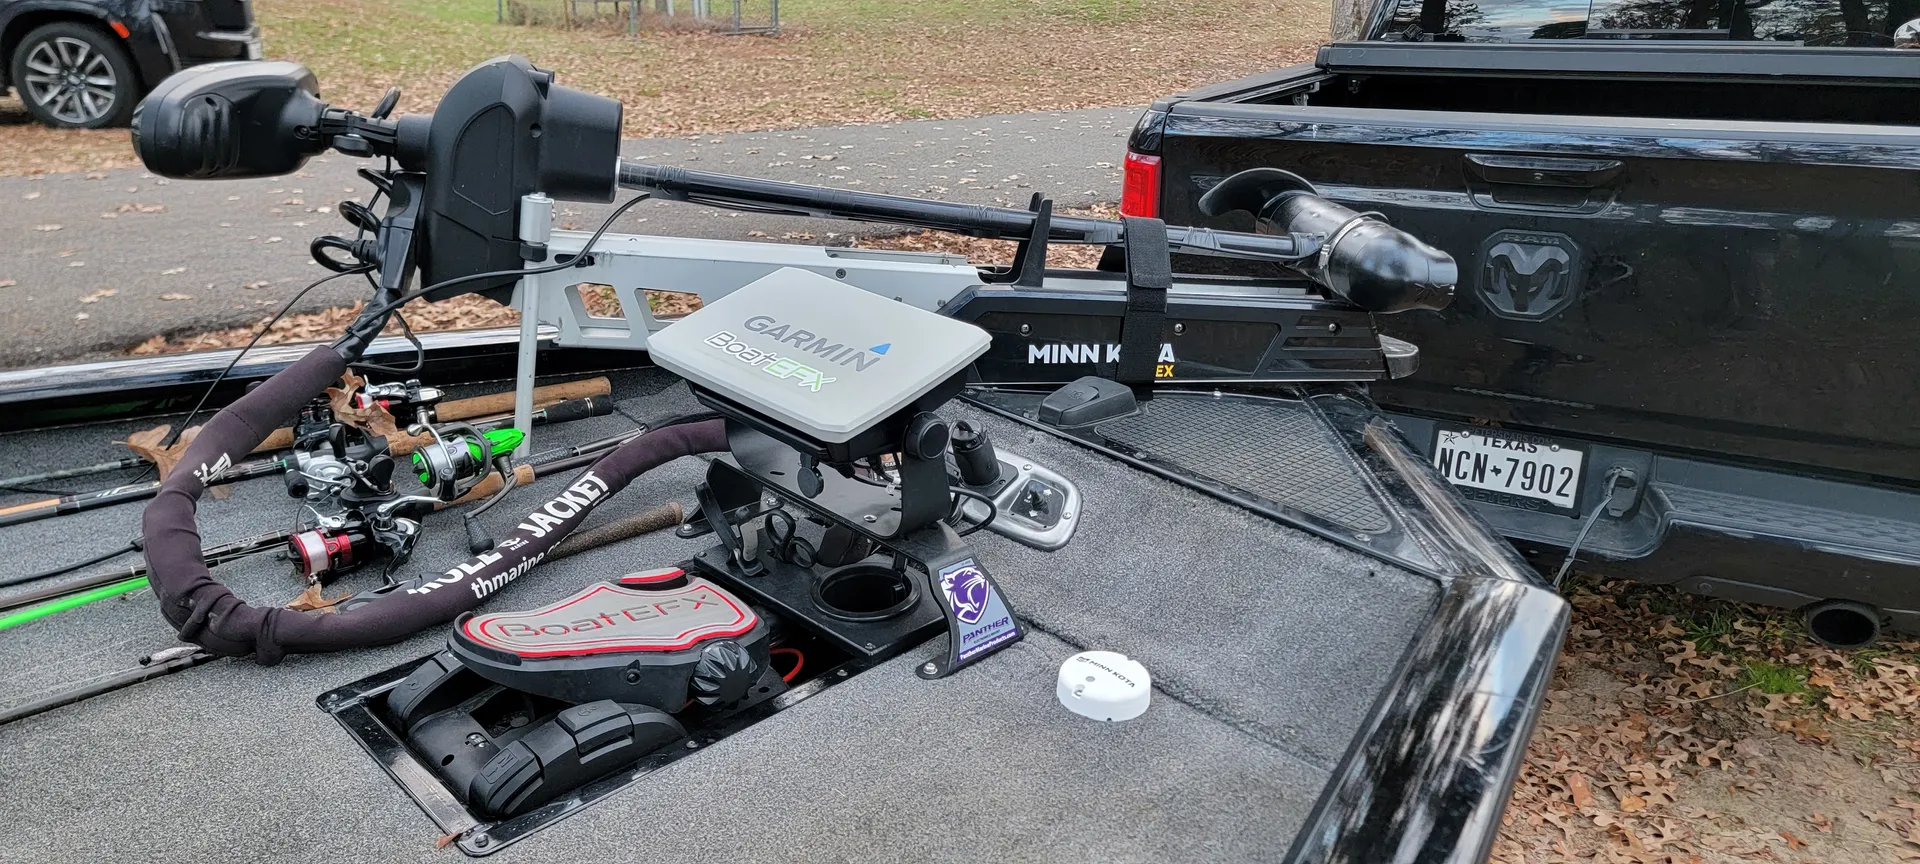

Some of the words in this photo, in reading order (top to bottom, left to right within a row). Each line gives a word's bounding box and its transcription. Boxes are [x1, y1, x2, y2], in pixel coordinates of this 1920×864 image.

[1503, 233, 1560, 245] RAM
[744, 315, 880, 372] GARMIN
[1028, 344, 1100, 364] MINN
[1106, 343, 1176, 363] KA
[704, 331, 836, 392] BoatEFX
[1482, 436, 1538, 454] TEXAS
[517, 470, 609, 538] JACKET
[497, 594, 719, 638] BoatEFX
[963, 616, 1009, 643] PANTHER
[1089, 660, 1113, 673] MINN
[1112, 671, 1136, 688] KOTA
